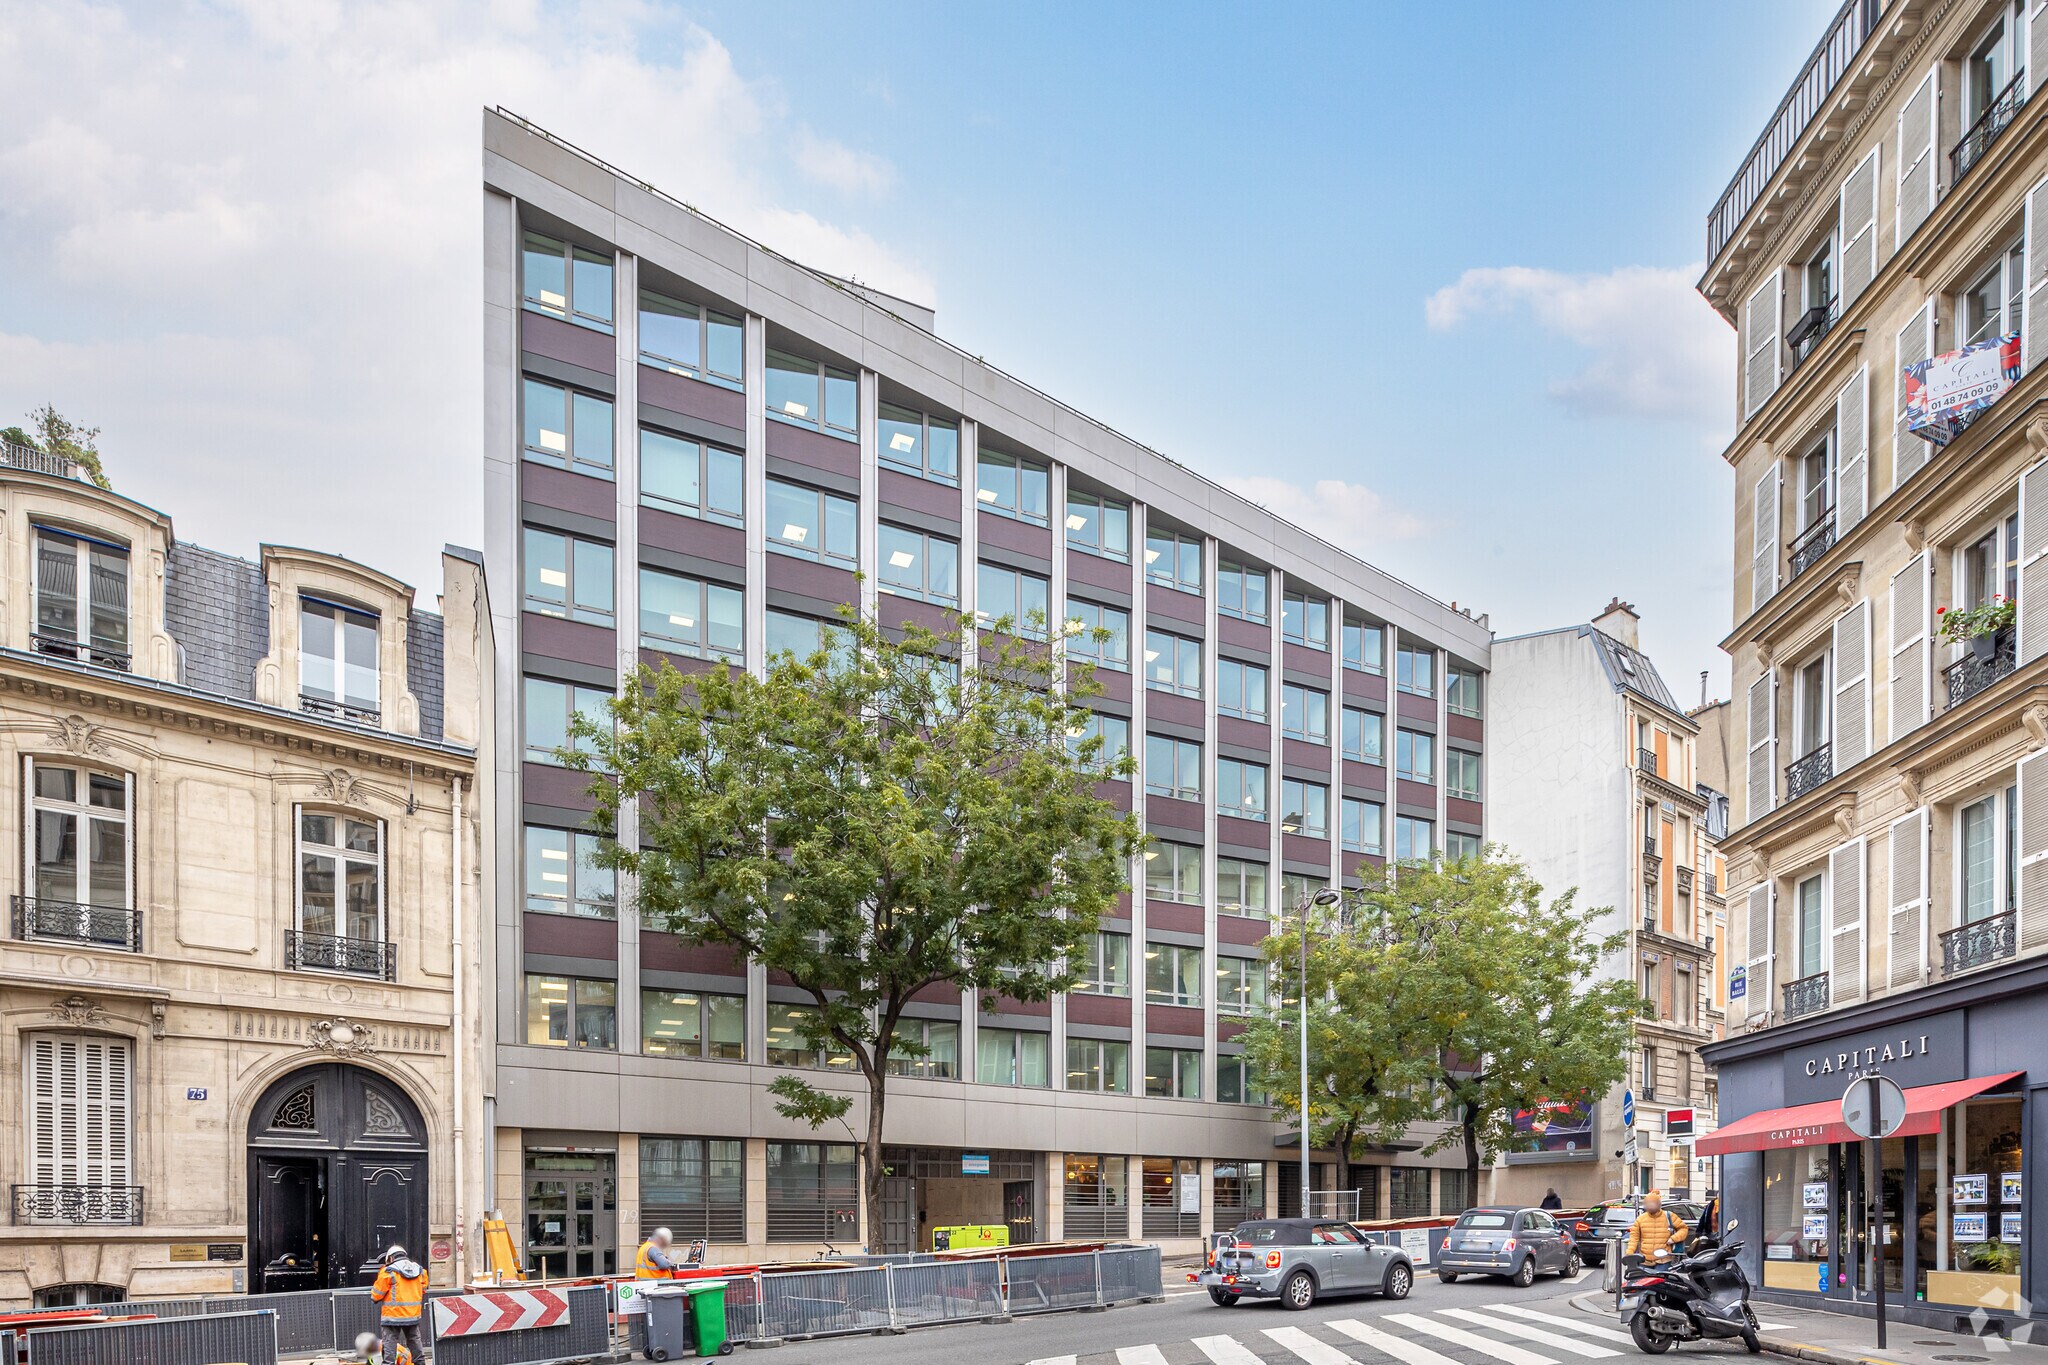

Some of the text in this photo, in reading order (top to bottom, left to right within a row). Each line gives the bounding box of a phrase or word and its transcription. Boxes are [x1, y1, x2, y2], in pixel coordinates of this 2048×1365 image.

[1933, 367, 1995, 392] CAPITALI
[1931, 382, 1999, 410] 01 48 74 09 09
[1805, 1036, 1928, 1076] CAPITALI
[190, 1089, 205, 1100] 75
[1771, 1126, 1823, 1140] CAPITALI
[620, 1209, 638, 1224] 79
